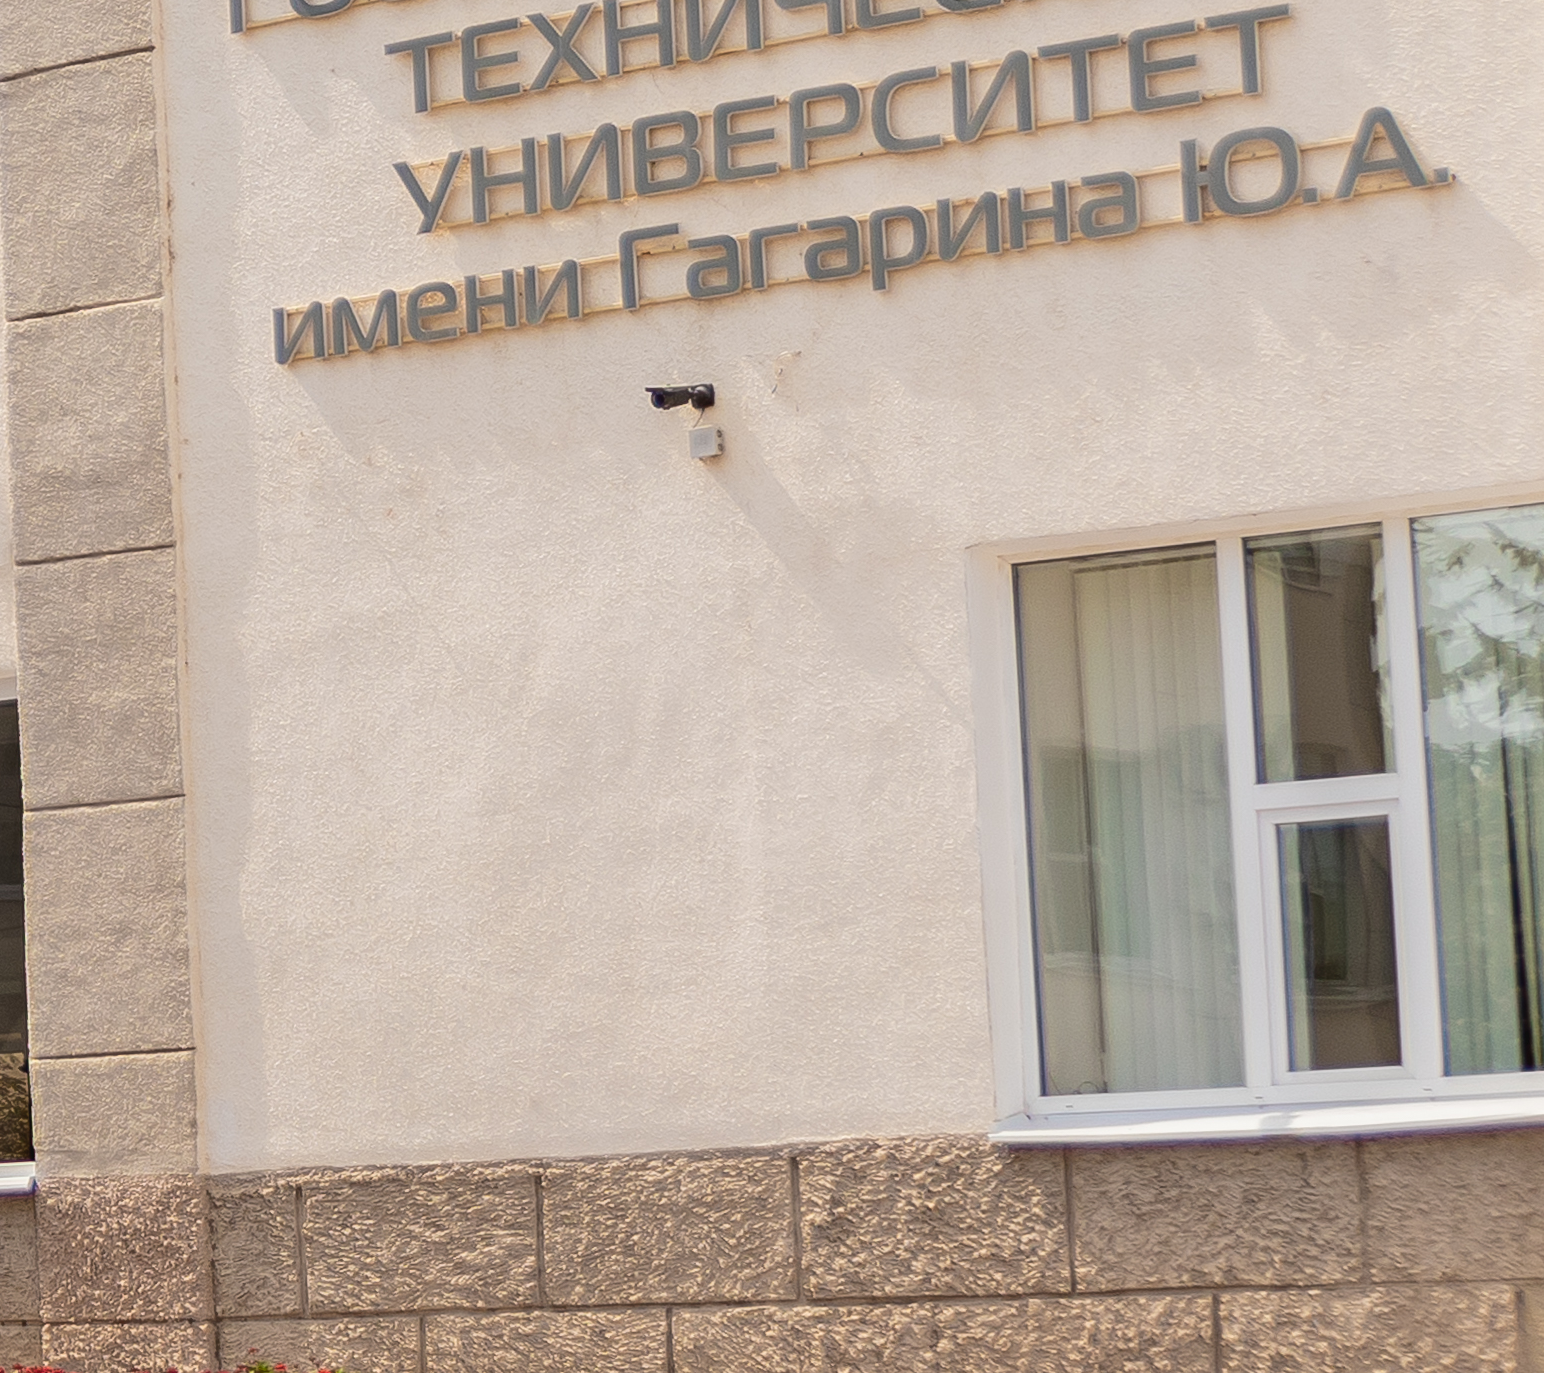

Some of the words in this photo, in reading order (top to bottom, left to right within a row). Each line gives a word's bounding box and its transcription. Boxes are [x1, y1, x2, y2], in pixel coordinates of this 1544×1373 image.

[392, 3, 1291, 235] УНИВЕРСИТЕТ
[272, 258, 582, 366] имени
[618, 168, 1141, 311] Гагарина
